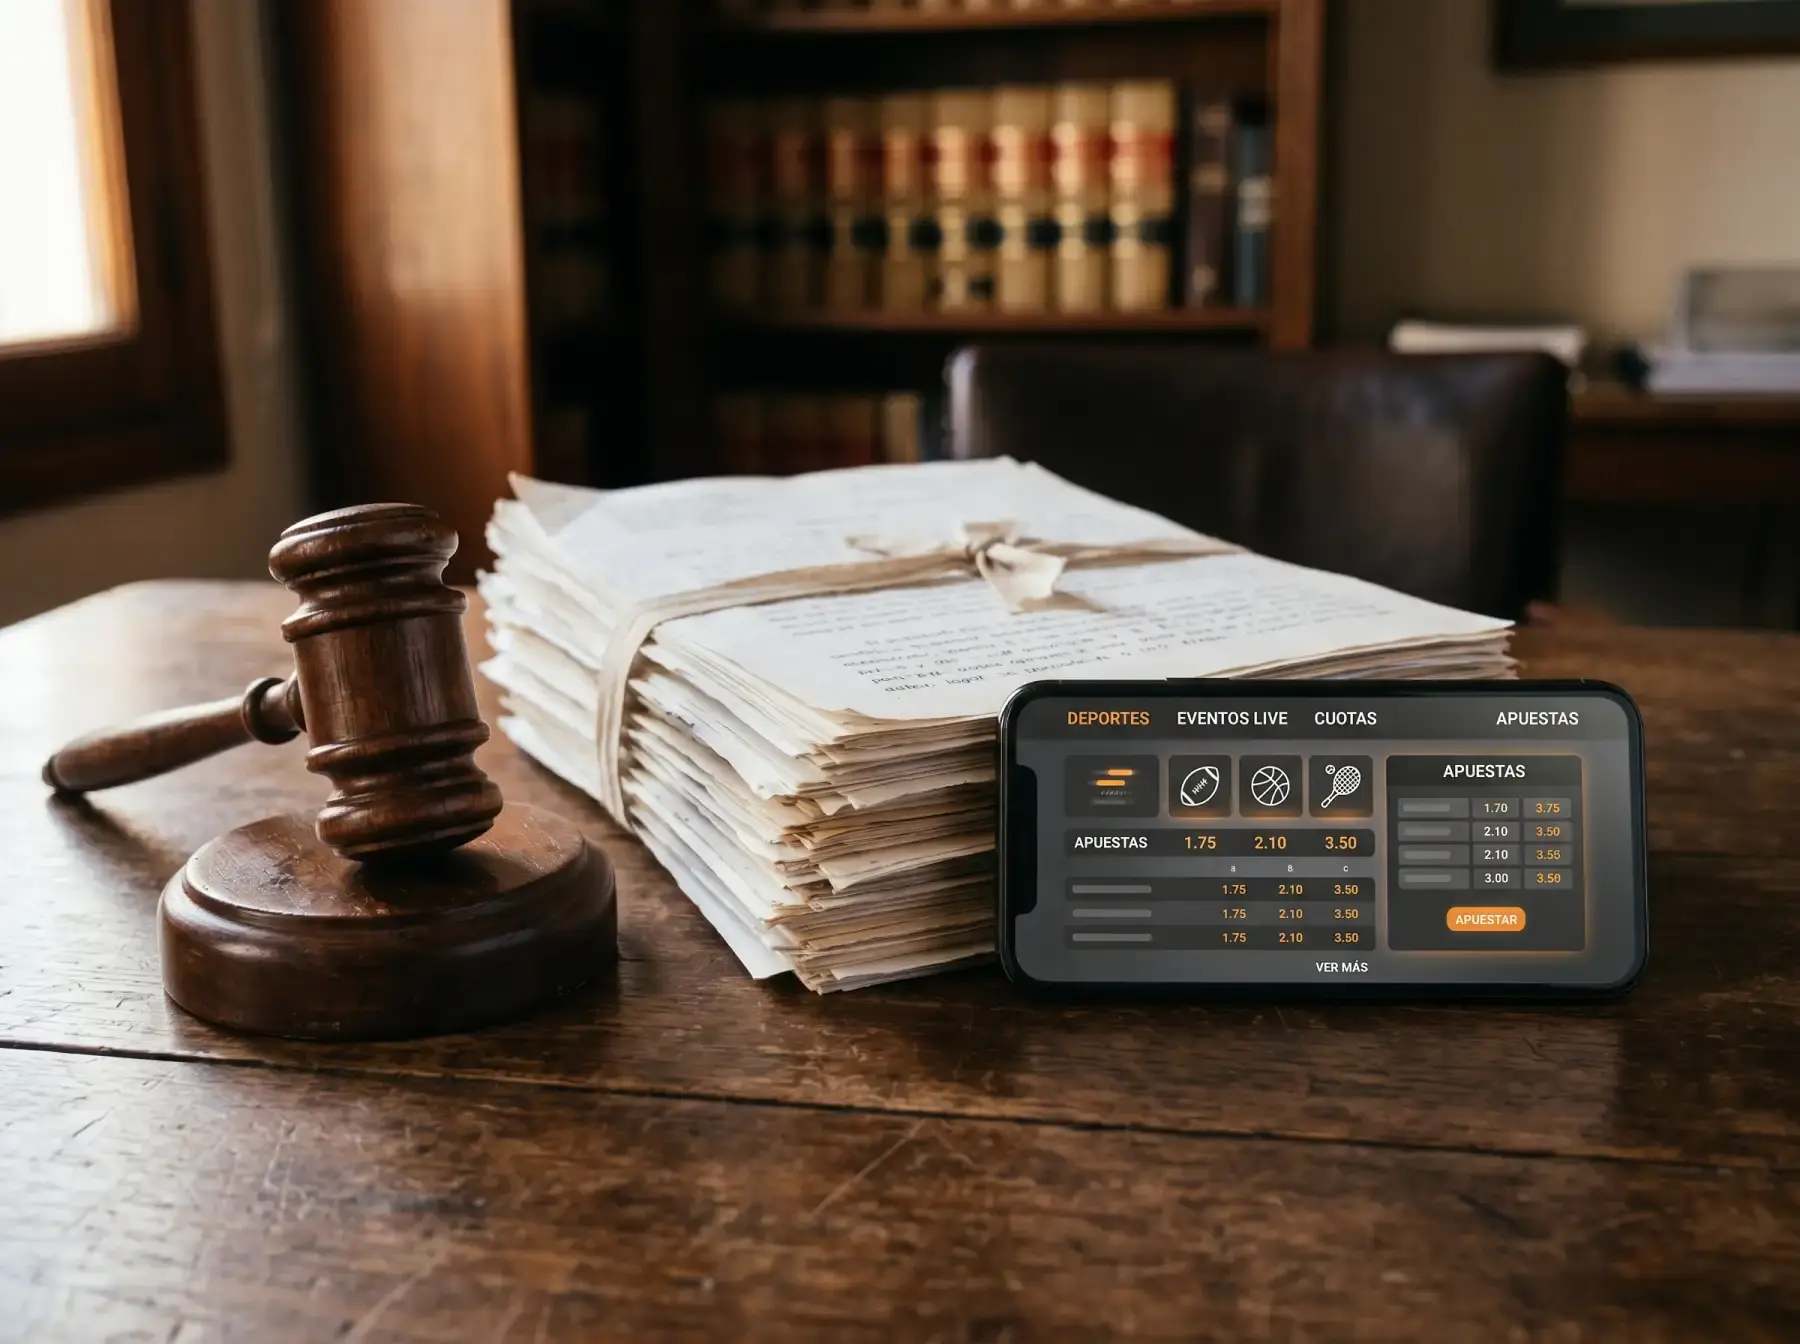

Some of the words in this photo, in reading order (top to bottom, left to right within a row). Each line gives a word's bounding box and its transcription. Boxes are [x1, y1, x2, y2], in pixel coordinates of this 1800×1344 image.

[1067, 711, 1150, 726] DEPORTES
[1177, 711, 1250, 726] EVENTOS
[1253, 711, 1288, 725] LIVE
[1314, 711, 1377, 726] CUOTAS
[1496, 711, 1579, 726] APUESTAS
[1442, 764, 1526, 778] APUESTAS
[1484, 802, 1508, 813] 1.70
[1535, 802, 1561, 814] 3.75
[1483, 826, 1508, 837] 2.10
[1536, 826, 1561, 837] 3.50
[1074, 836, 1148, 849] APUESTAS
[1184, 835, 1217, 850] 1.75
[1254, 836, 1287, 850] 2.10
[1325, 835, 1357, 850] 3.50
[1484, 849, 1509, 860] 2.10
[1484, 872, 1509, 884] 3.00
[1536, 872, 1561, 884] 3.50
[1222, 884, 1247, 895] 1.75
[1278, 884, 1303, 895] 2.10
[1334, 884, 1359, 895] 3.50
[1222, 908, 1247, 919] 1.75
[1278, 908, 1303, 919] 2.10
[1334, 908, 1359, 919] 3.50
[1455, 914, 1518, 925] APUESTAR
[1222, 932, 1247, 943] 1.75
[1278, 932, 1303, 943] 2.10
[1334, 932, 1359, 943] 3.50
[1315, 962, 1339, 973] VER
[1341, 959, 1369, 973] MÁS
